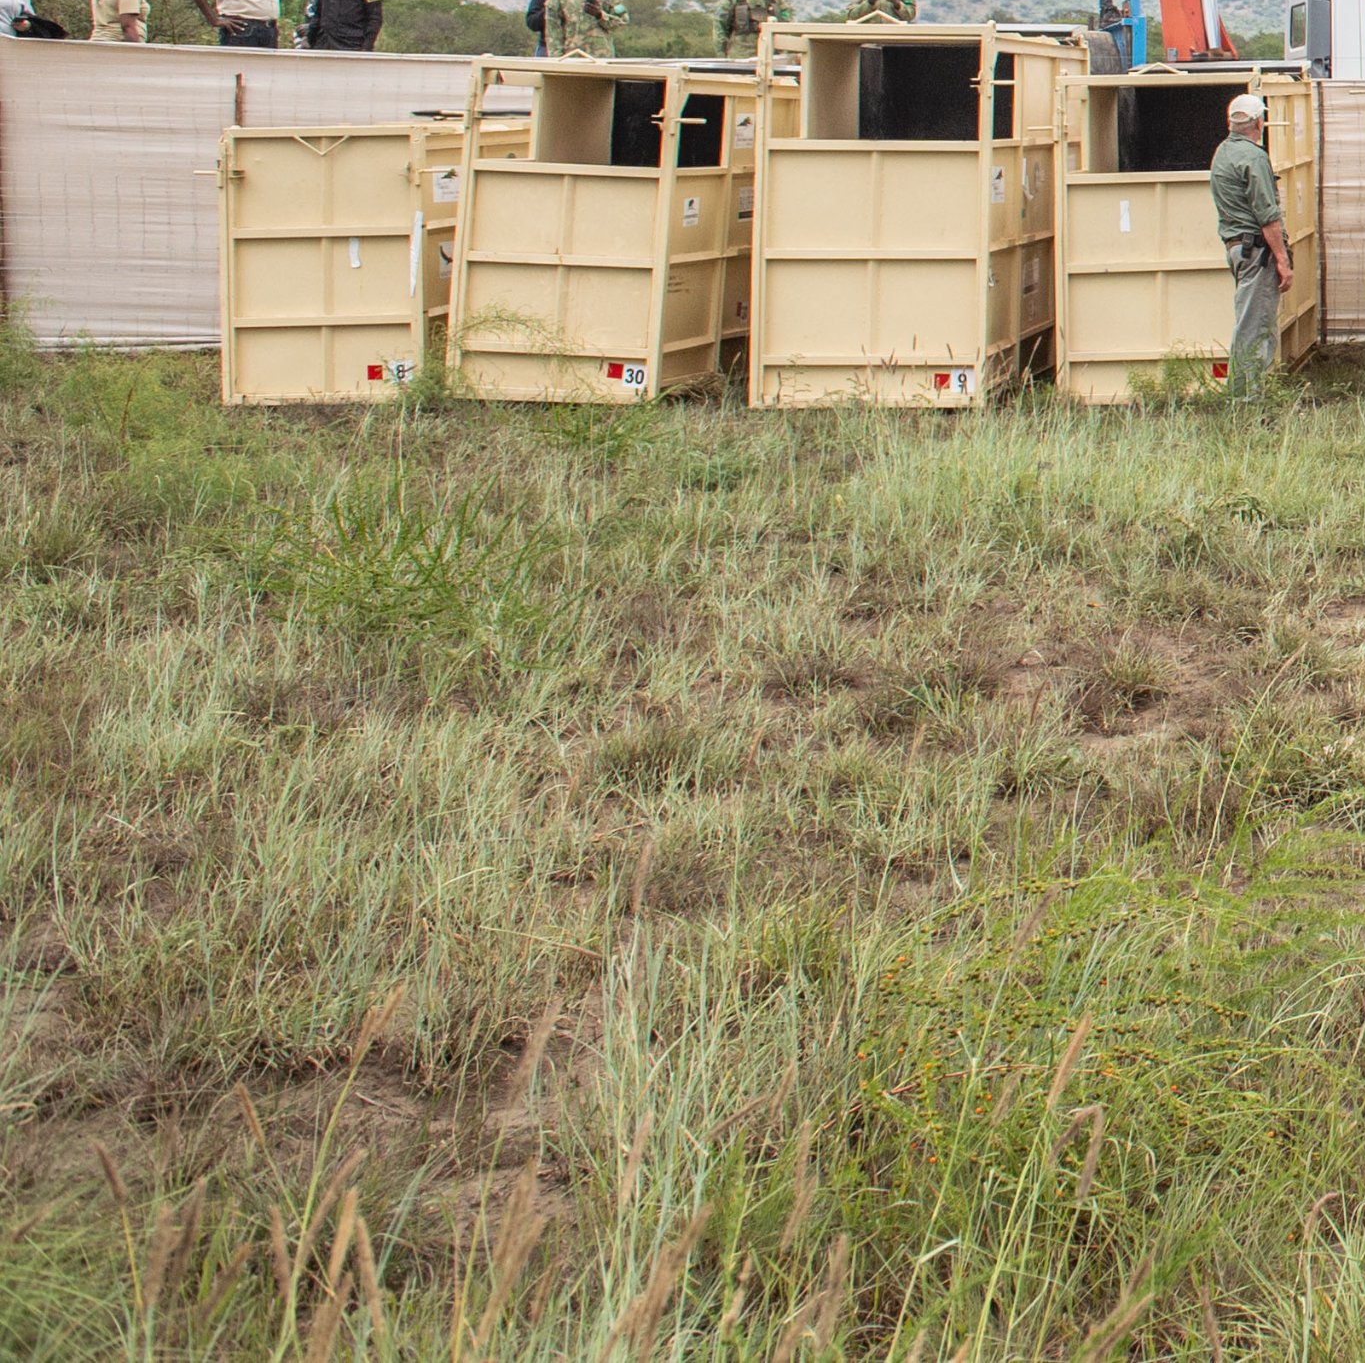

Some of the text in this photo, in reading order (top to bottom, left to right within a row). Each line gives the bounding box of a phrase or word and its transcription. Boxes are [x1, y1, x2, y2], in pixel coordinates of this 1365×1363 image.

[396, 364, 406, 379] 8
[625, 368, 645, 384] 30
[958, 373, 967, 389] 9
